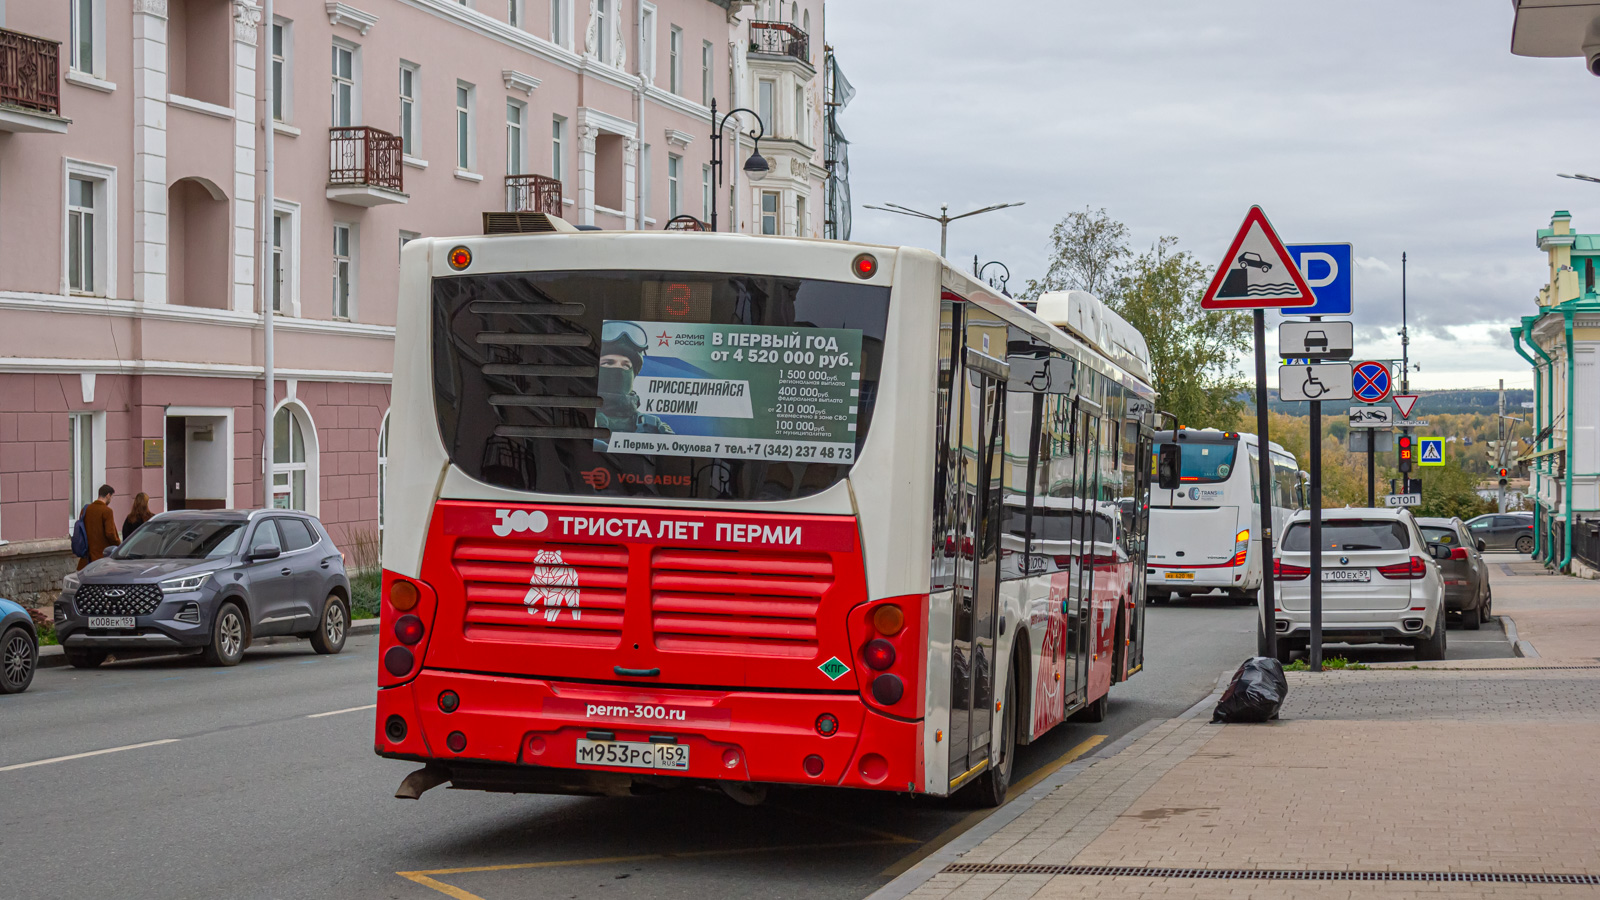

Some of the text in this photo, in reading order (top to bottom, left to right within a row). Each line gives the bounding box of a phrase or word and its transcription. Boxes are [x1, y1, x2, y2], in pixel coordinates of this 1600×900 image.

[1300, 252, 1338, 287] P
[666, 284, 691, 315] 3
[712, 331, 838, 352] В ПЕРВЫЙ ГОД
[710, 349, 853, 368] от 4 520 000 руб.
[779, 369, 783, 378] 1
[787, 370, 806, 379] 500
[648, 380, 745, 397] ПРИСОЕДИНЯЙСЯ
[778, 386, 797, 396] 400
[645, 399, 698, 414] К СВОИМ!
[776, 403, 795, 413] 210
[776, 420, 793, 430] 100
[614, 440, 621, 448] г.
[623, 439, 654, 451] Пермь
[656, 442, 669, 452] ул.
[672, 441, 712, 453] Окулова
[714, 443, 720, 453] 7
[763, 444, 793, 458] (342)
[795, 446, 816, 457] 237
[820, 447, 835, 458] 48
[838, 448, 852, 459] 73
[1401, 450, 1411, 459] 30
[617, 473, 692, 486] VOLGABUS
[1390, 496, 1416, 505] СТОП
[492, 509, 802, 545] 300 ТРИСТА ЛЕТ ПЕРМИ
[90, 617, 120, 627] К008ЕК
[825, 664, 844, 673] КПГ
[586, 703, 687, 721] perm-300.ru
[582, 743, 684, 765] М953РС 159
